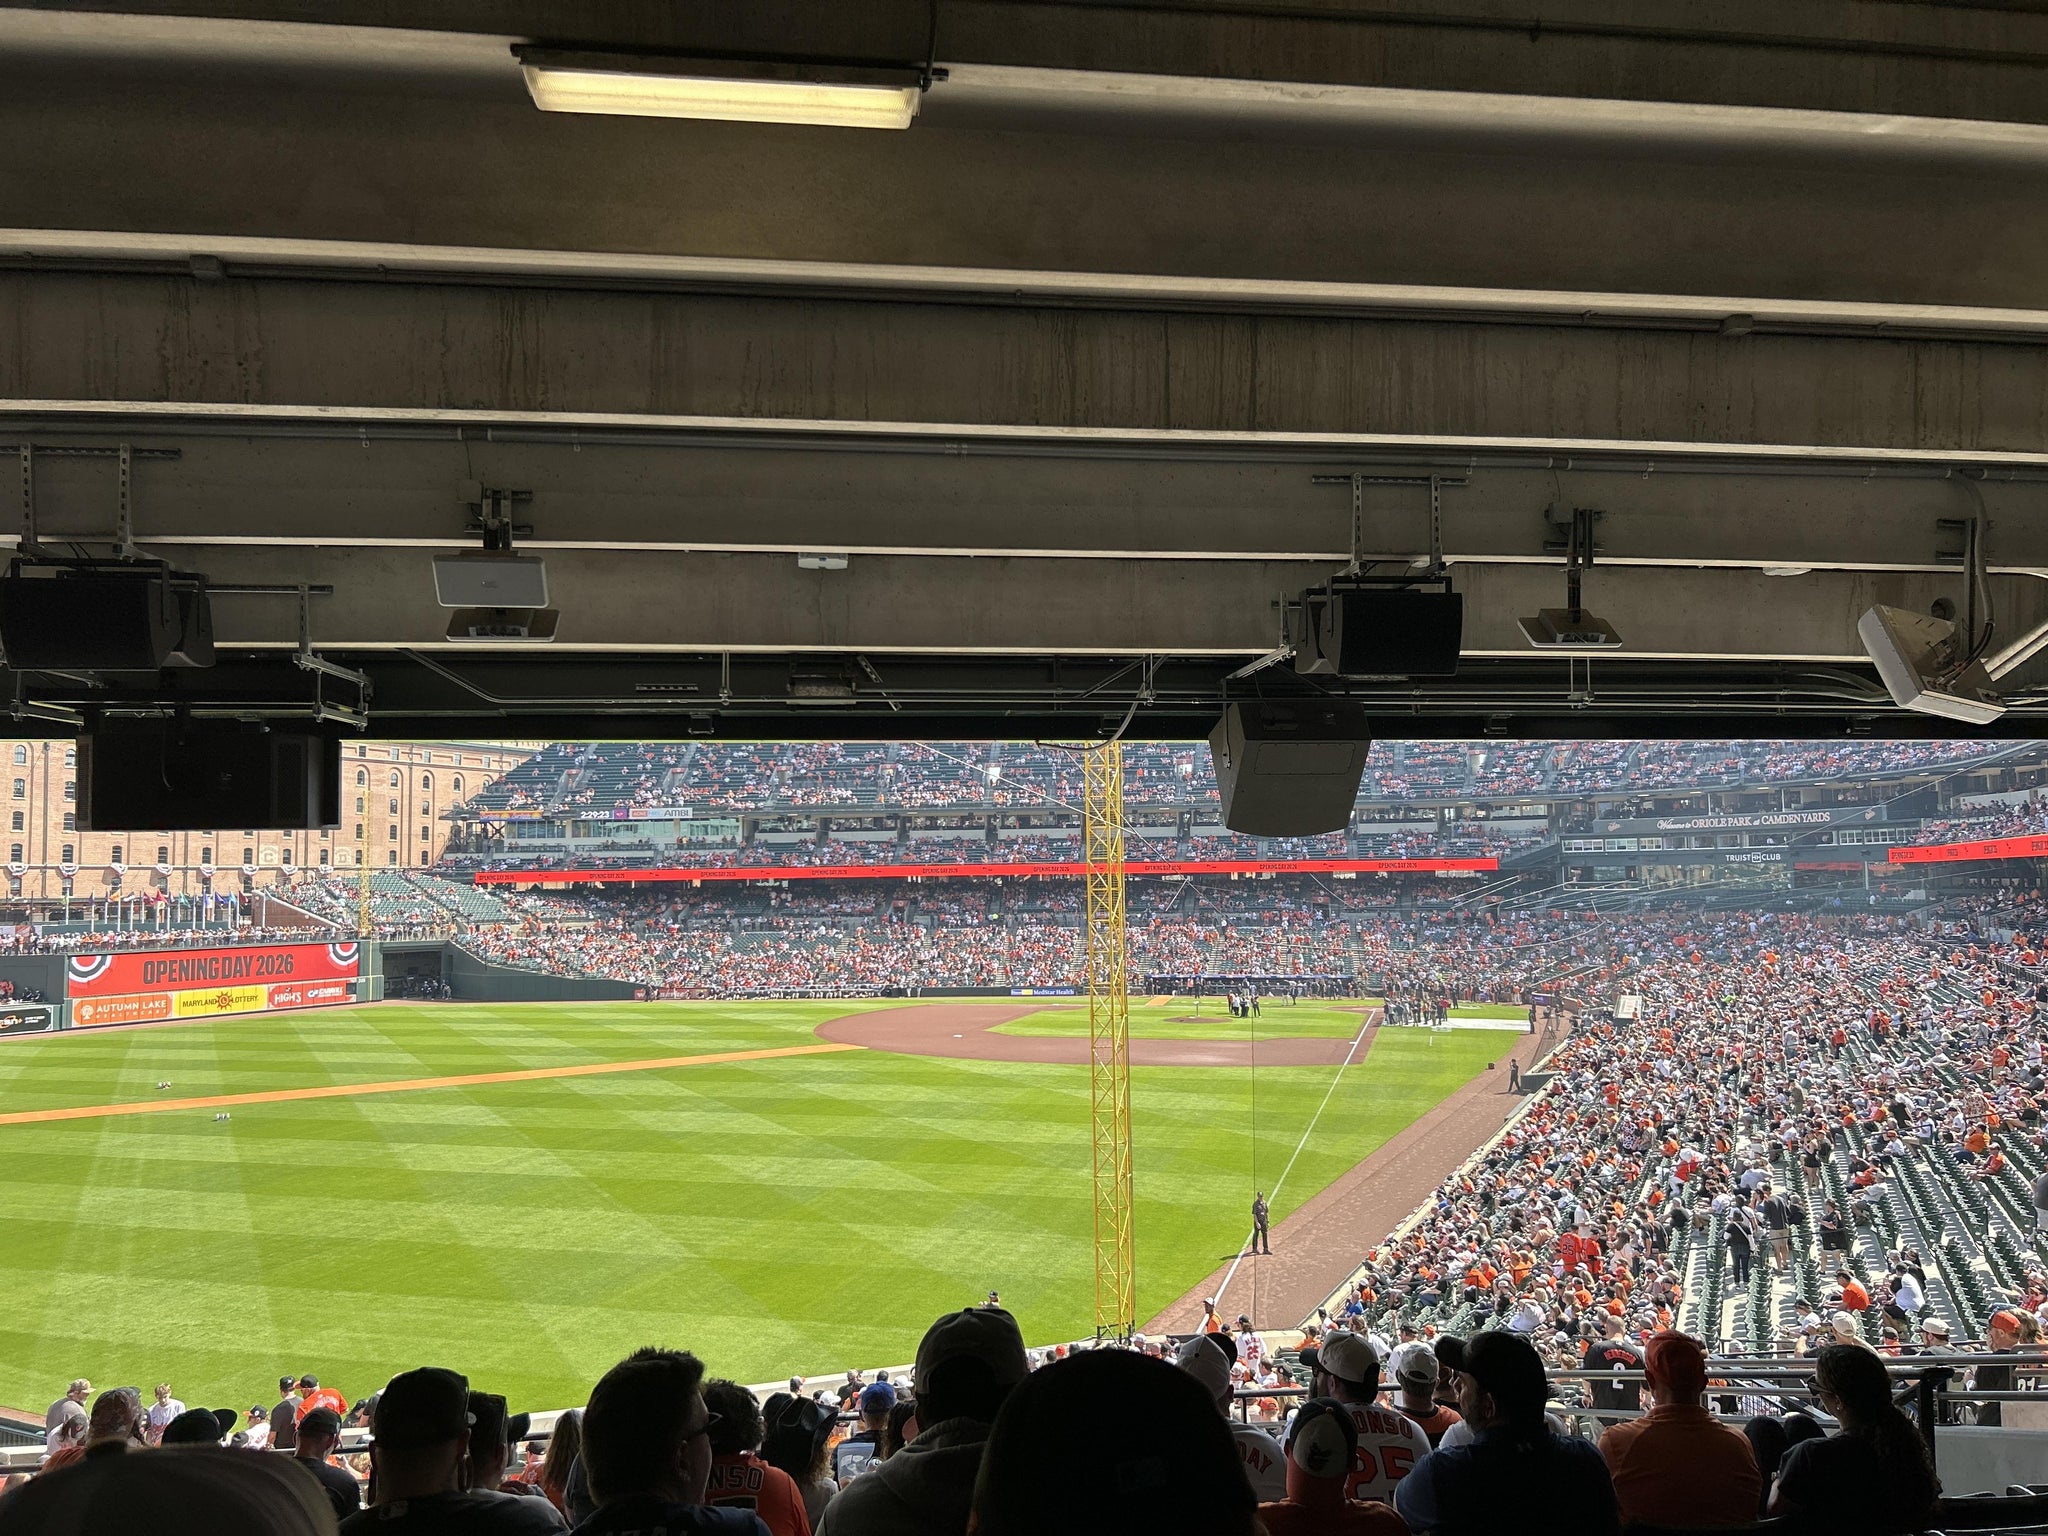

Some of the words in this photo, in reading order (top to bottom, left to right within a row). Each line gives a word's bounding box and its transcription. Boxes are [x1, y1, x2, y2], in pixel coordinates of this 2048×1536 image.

[664, 809, 689, 817] AMBI
[1657, 818, 1685, 830] Welcome
[1691, 817, 1727, 828] ORIOLE
[1728, 816, 1752, 827] PARK
[1761, 813, 1801, 825] CAMDEN
[1802, 811, 1831, 823] YARDS
[1725, 854, 1751, 862] TRUIST
[1761, 853, 1781, 861] CLUB
[143, 957, 220, 985] OPENING
[221, 955, 254, 980] DAY
[255, 953, 294, 976] 2026
[182, 998, 218, 1008] MARYLAND
[231, 995, 258, 1004] LOTTERY
[274, 991, 302, 1005] HIGH'S
[96, 1001, 140, 1013] AUTUMN
[143, 999, 168, 1009] LAKE
[1343, 1445, 1416, 1500] 25
